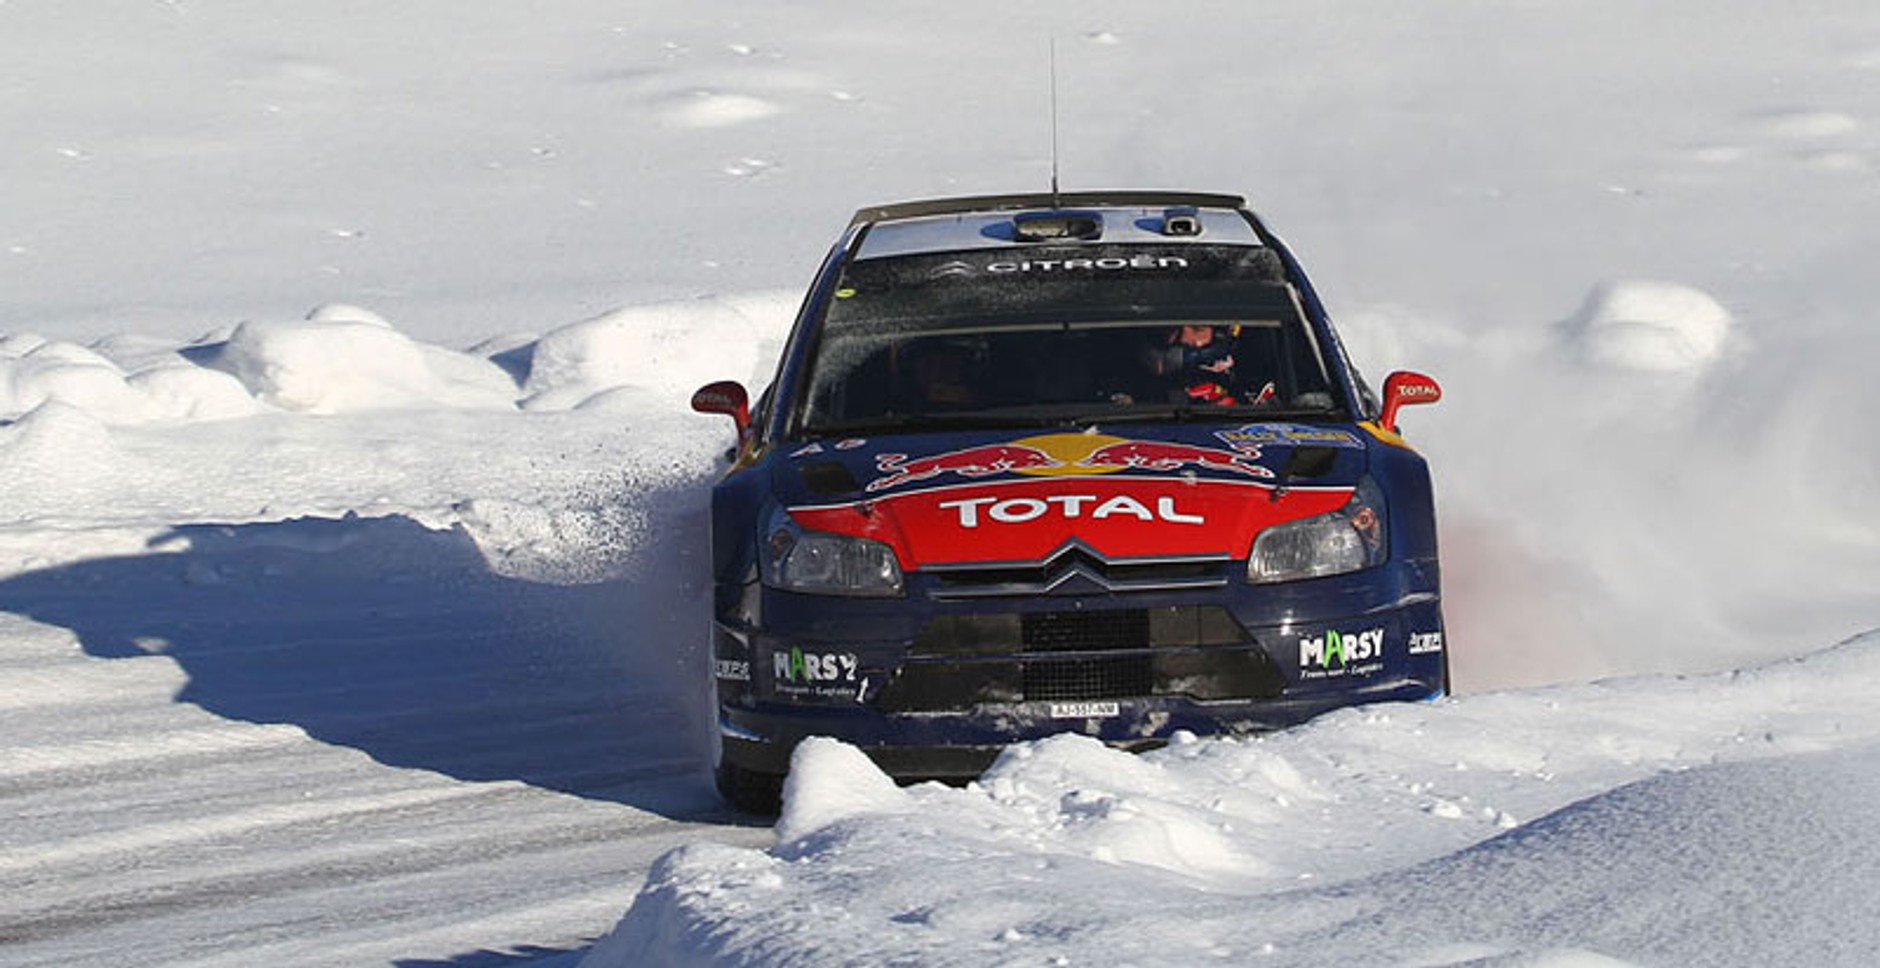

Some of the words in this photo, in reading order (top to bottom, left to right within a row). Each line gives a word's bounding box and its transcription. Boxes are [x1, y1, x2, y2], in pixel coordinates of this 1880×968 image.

[1397, 384, 1439, 397] TOTAL
[939, 495, 1204, 528] TOTAL
[773, 646, 858, 685] MARSY
[1299, 629, 1384, 669] MARSY
